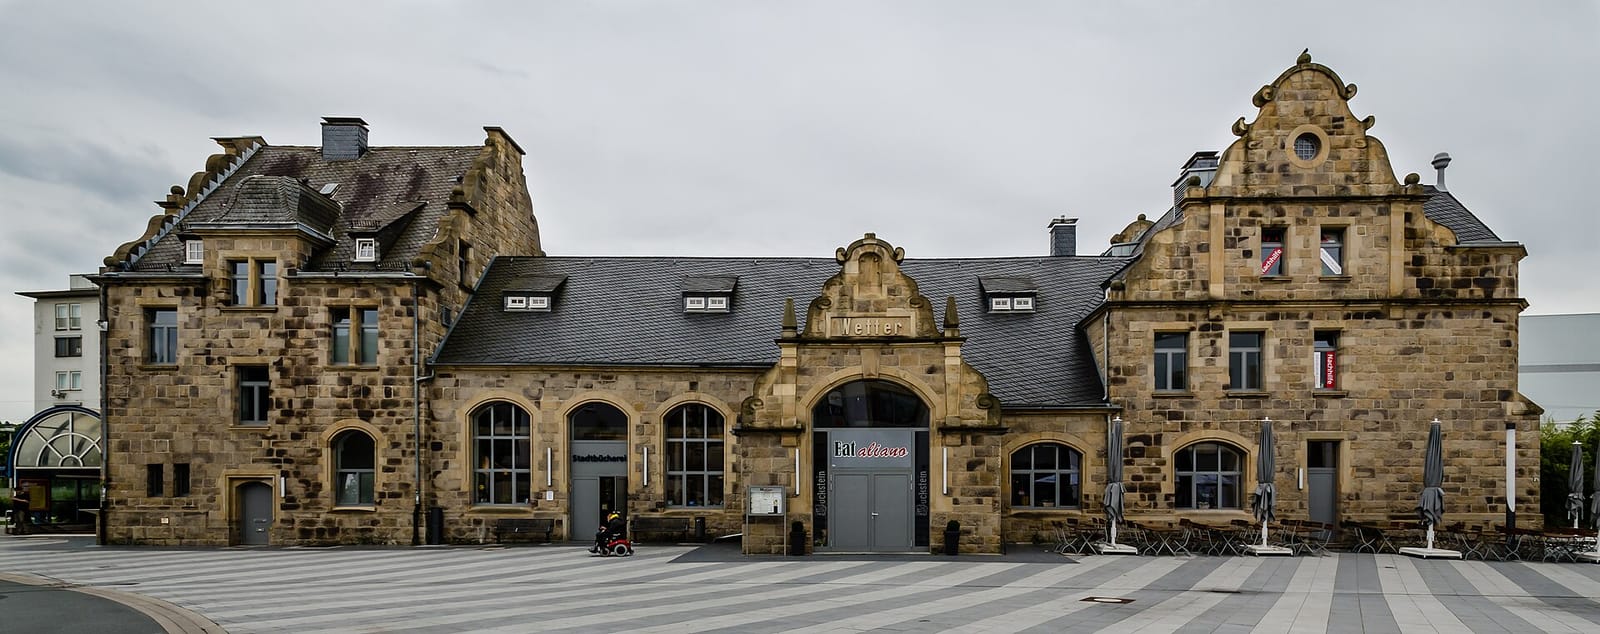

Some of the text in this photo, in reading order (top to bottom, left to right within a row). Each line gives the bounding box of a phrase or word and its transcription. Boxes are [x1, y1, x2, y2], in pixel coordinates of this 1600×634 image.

[841, 318, 903, 336] Wetter
[834, 440, 908, 457] Eat aliano
[572, 454, 627, 462] Stadtbücherei
